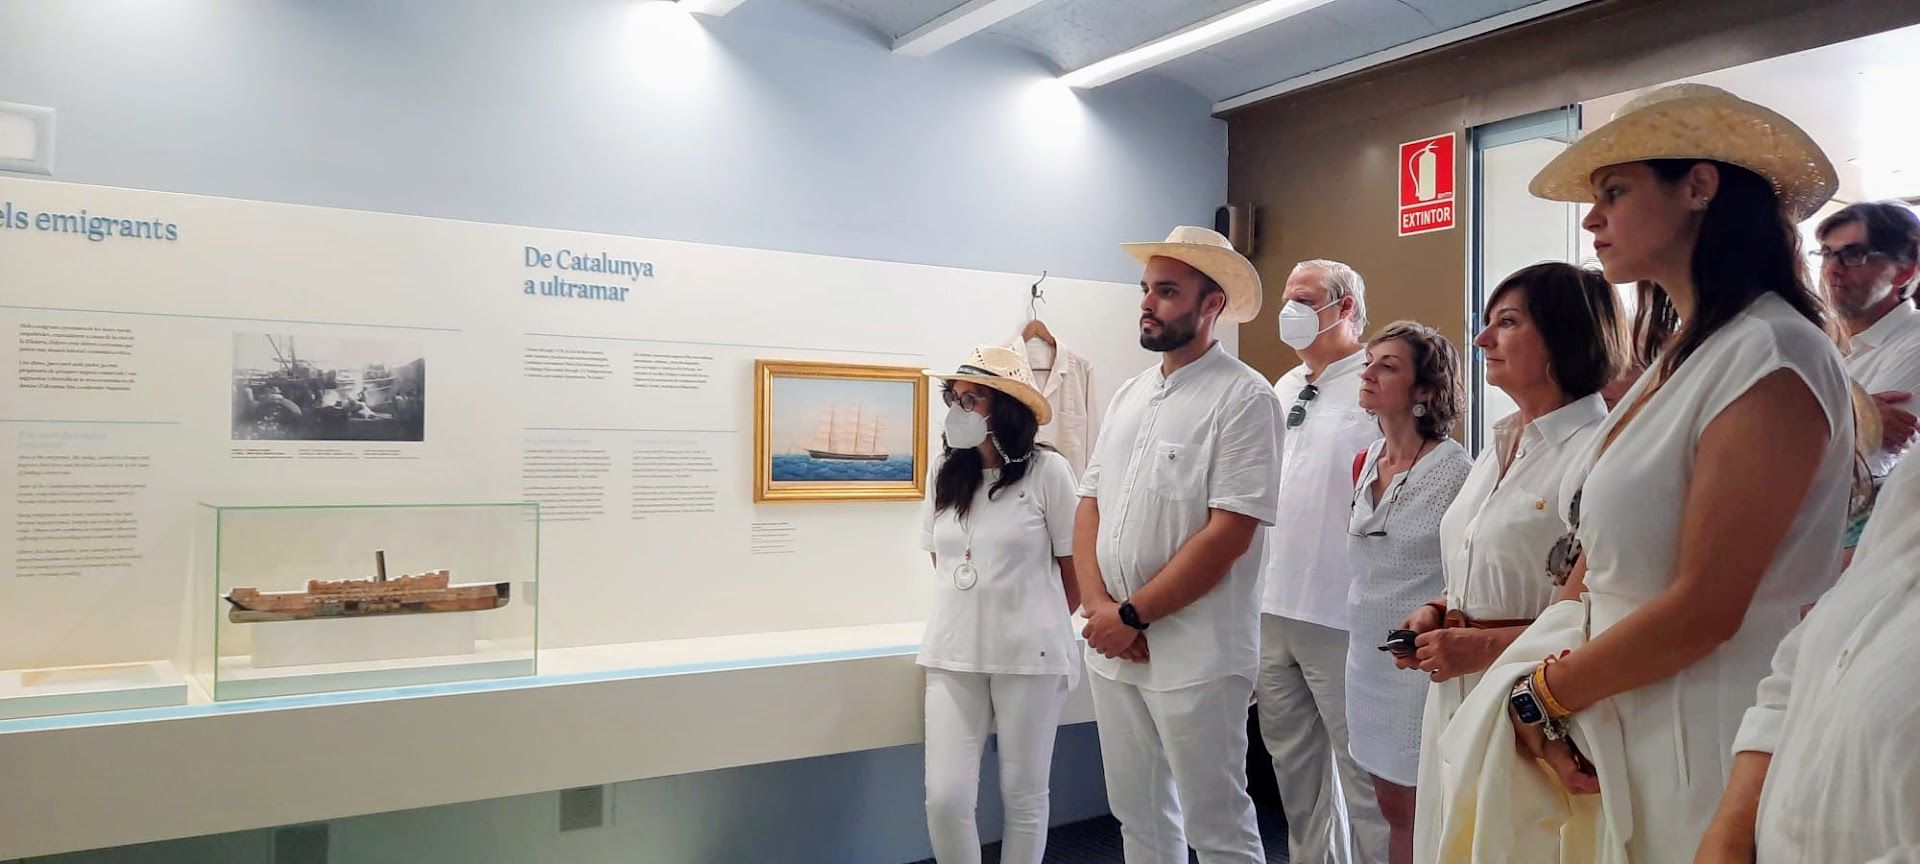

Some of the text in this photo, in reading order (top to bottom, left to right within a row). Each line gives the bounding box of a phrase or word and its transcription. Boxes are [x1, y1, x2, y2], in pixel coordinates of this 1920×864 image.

[35, 209, 178, 242] emigrants
[1402, 206, 1451, 228] EXTINTOR
[524, 246, 654, 281] De Catalunya
[523, 275, 630, 302] a ultramar
